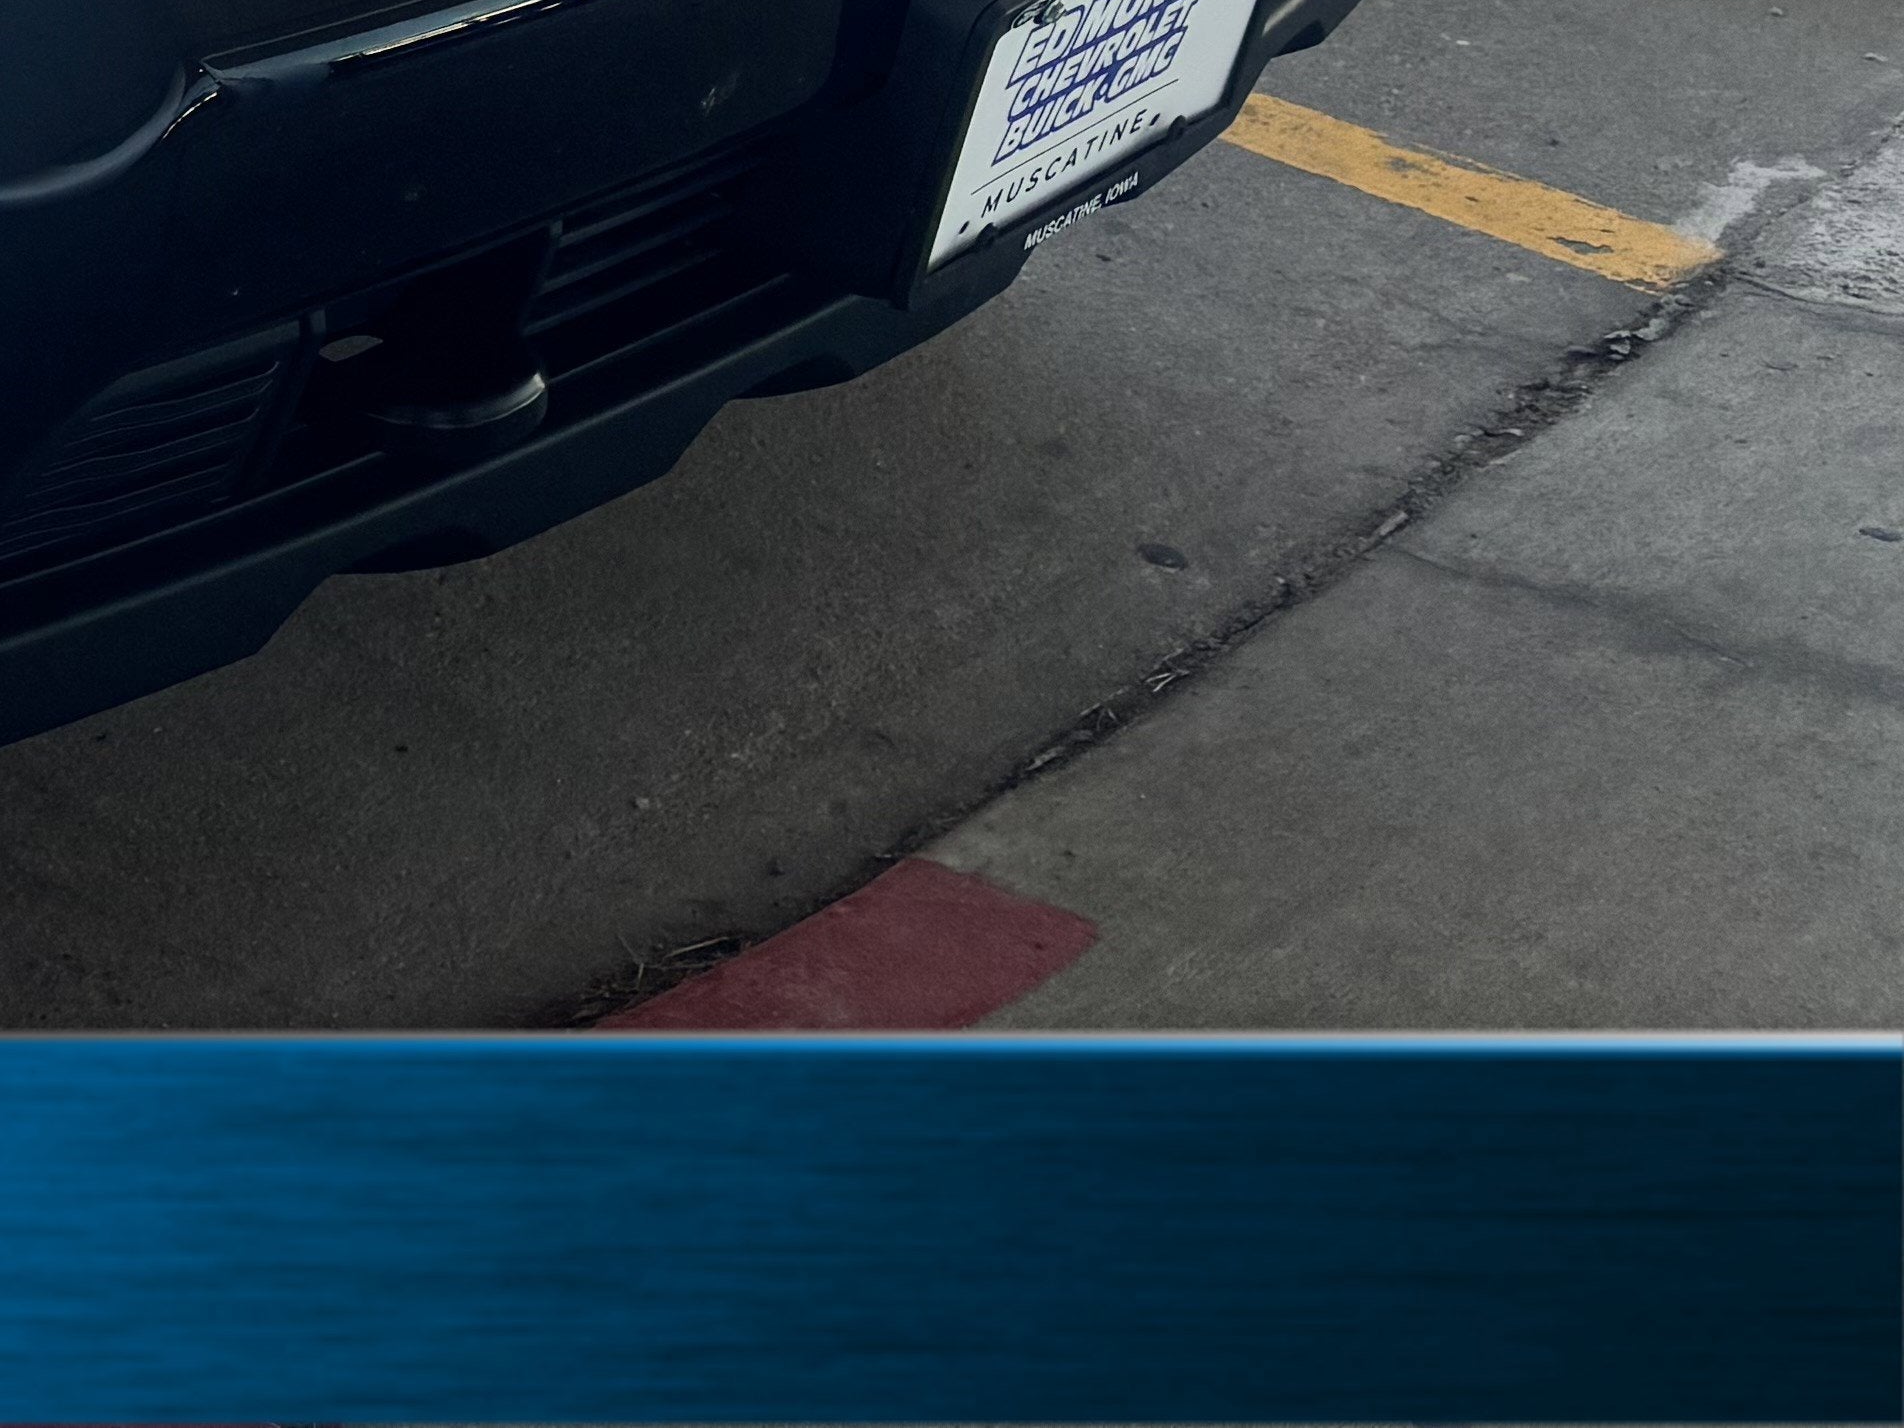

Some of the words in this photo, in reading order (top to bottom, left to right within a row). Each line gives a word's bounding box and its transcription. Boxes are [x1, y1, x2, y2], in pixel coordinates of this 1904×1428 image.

[1008, 6, 1083, 88] ED
[981, 109, 1148, 218] MUSCATINE
[1105, 171, 1139, 204] IOWA
